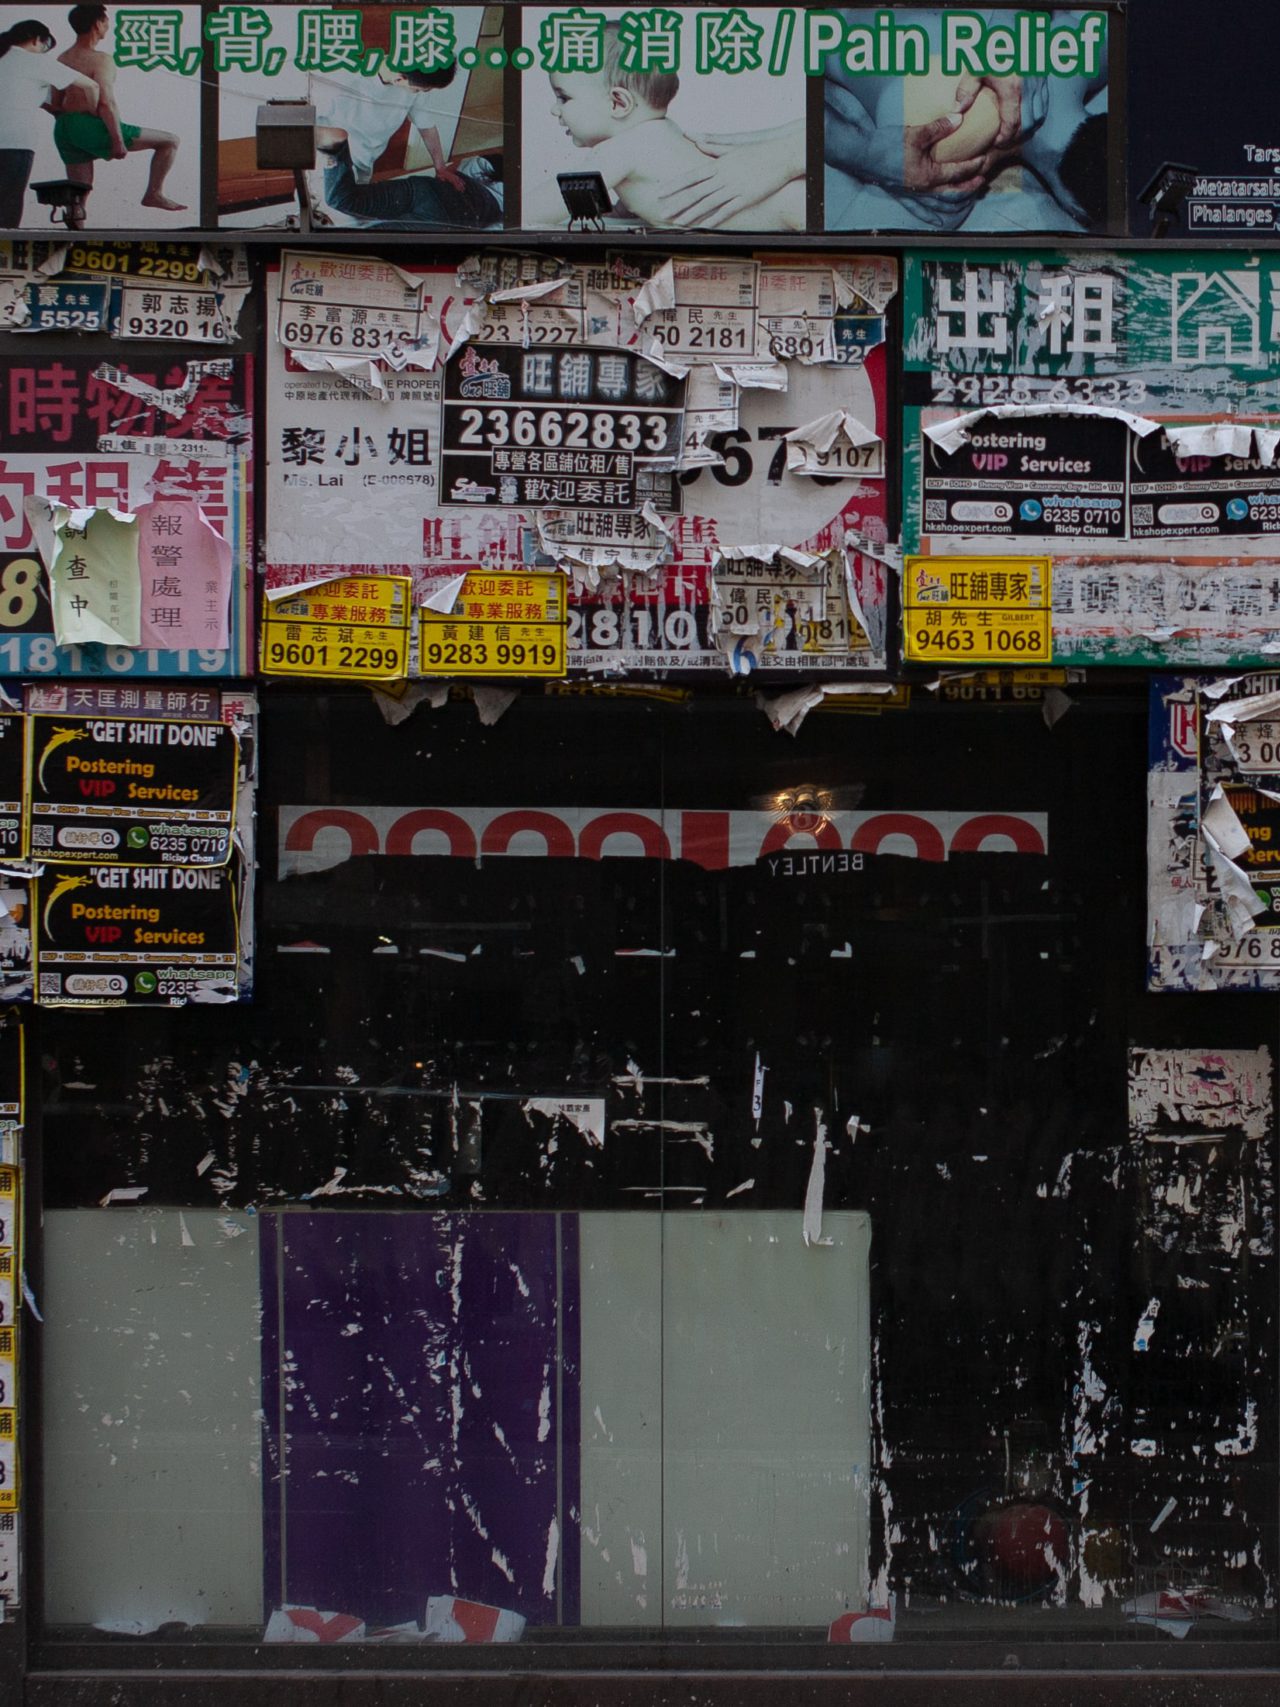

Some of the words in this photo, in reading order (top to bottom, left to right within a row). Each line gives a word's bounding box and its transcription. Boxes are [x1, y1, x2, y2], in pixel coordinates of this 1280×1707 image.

[808, 14, 926, 74] Pain
[945, 11, 1103, 74] Relief
[1193, 178, 1280, 198] Metatarsals
[1193, 204, 1273, 226] Phalanges
[71, 250, 129, 273] 9601
[140, 257, 200, 282] 2299
[40, 310, 99, 328] 5525
[935, 271, 1118, 356] 出租
[129, 318, 188, 338] 9320
[284, 322, 344, 346] 6976
[689, 326, 747, 349] 2181
[460, 408, 668, 451] 23662833
[282, 426, 433, 467] 黎小姐
[971, 453, 1009, 471] VIP
[1019, 454, 1092, 474] Services
[318, 473, 344, 487] Lai
[1042, 494, 1122, 509] whatsapp
[1043, 508, 1080, 524] 6235
[1084, 509, 1121, 525] 0710
[925, 522, 1013, 535] hkshopexpert.com
[1054, 524, 1081, 536] Ricky
[1082, 525, 1109, 536] Chan
[151, 514, 183, 629] 報警處理
[950, 571, 1029, 602] 旺舖專家
[311, 603, 387, 623] 專業服務
[468, 602, 543, 621] 專業服務
[925, 611, 994, 628] 胡先生
[1001, 613, 1036, 623] GILBERT
[916, 629, 976, 652] 9463
[983, 630, 1042, 652] 1068
[271, 643, 329, 667] 9601
[338, 647, 400, 670] 2299
[427, 643, 488, 666] 9283
[495, 644, 557, 667] 9919
[74, 687, 212, 713] 天匡測量師行
[128, 722, 165, 745] SHIT
[66, 755, 156, 778] Postering
[79, 778, 117, 798] VIP
[127, 782, 200, 801] Services
[150, 837, 190, 852] 6235
[193, 837, 228, 853] 0710
[133, 868, 169, 890] SHIT
[71, 902, 161, 923] Postering
[85, 925, 124, 944] VIP
[134, 927, 206, 946] Services
[157, 966, 236, 981] whatsapp
